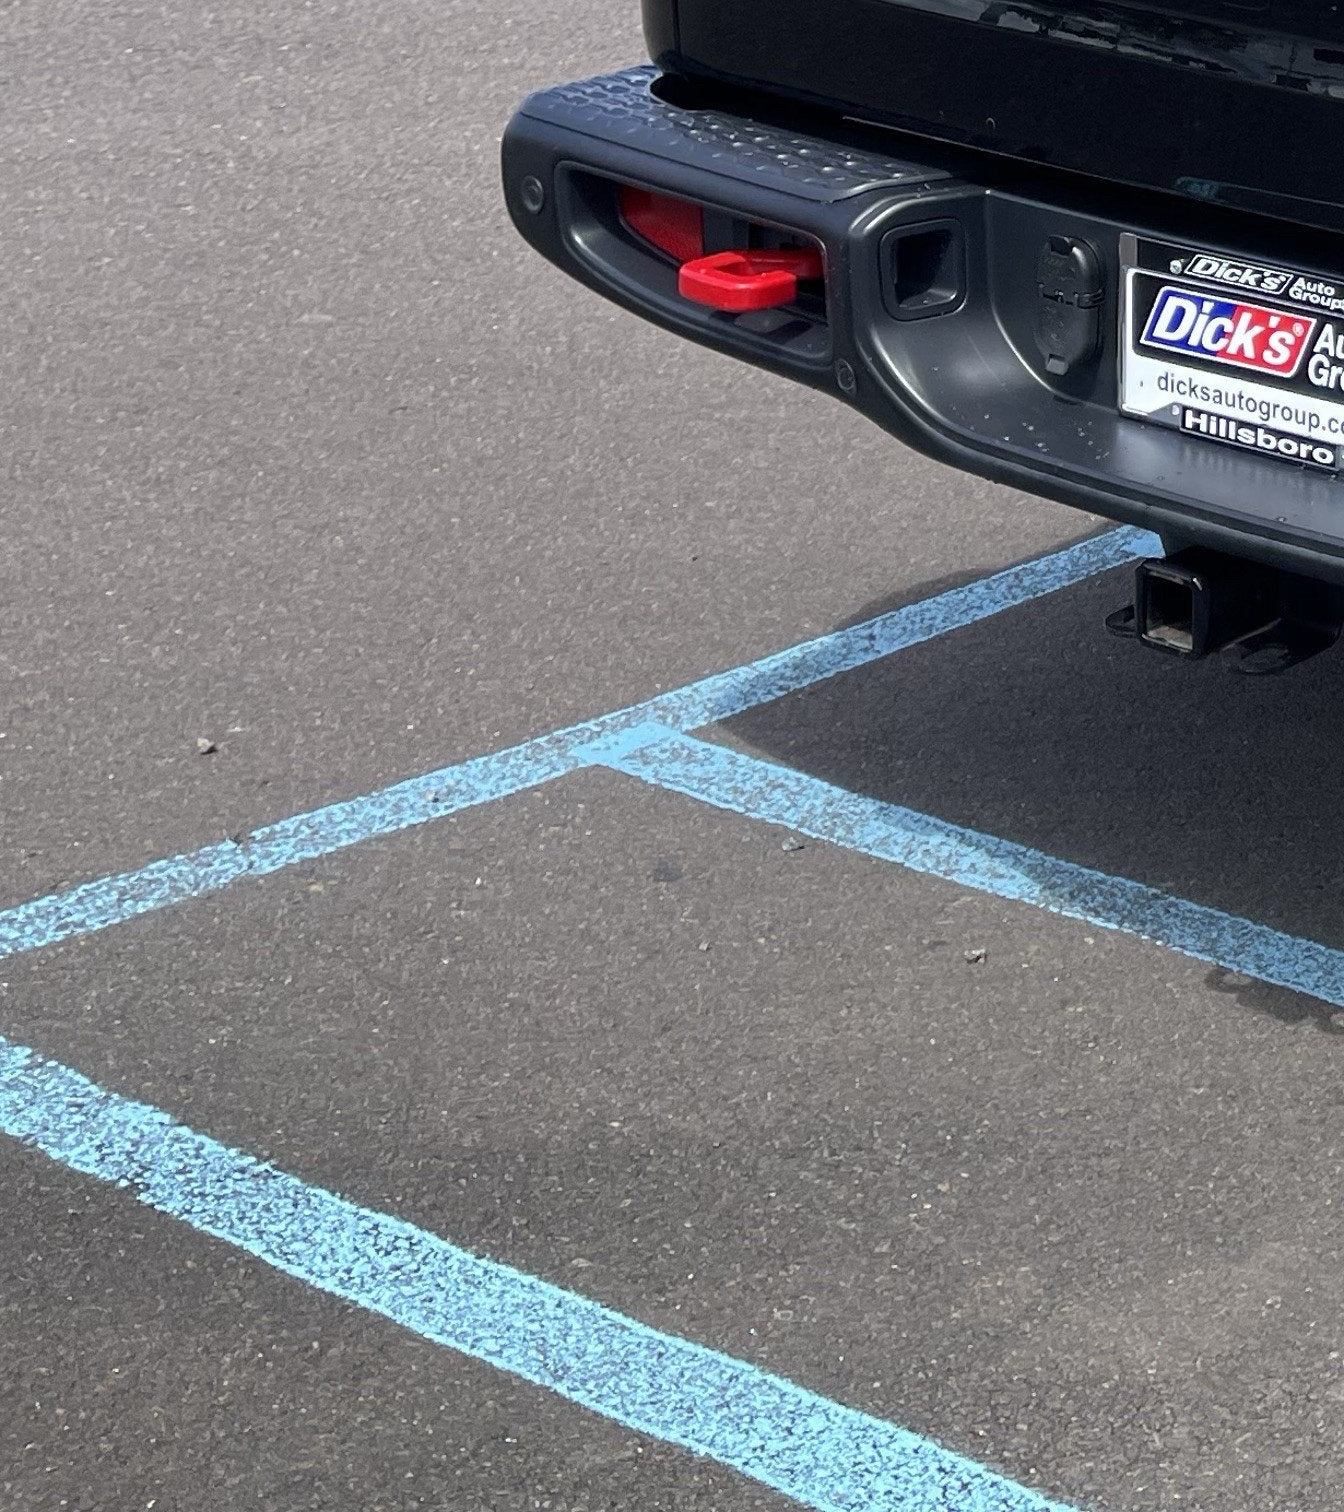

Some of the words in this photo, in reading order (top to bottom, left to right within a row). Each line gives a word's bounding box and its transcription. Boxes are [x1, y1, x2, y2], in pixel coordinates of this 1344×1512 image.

[1191, 258, 1288, 291] Dick's
[1293, 277, 1336, 296] Auto
[1152, 295, 1296, 366] Dick's
[1184, 409, 1335, 465] Hillsboro
